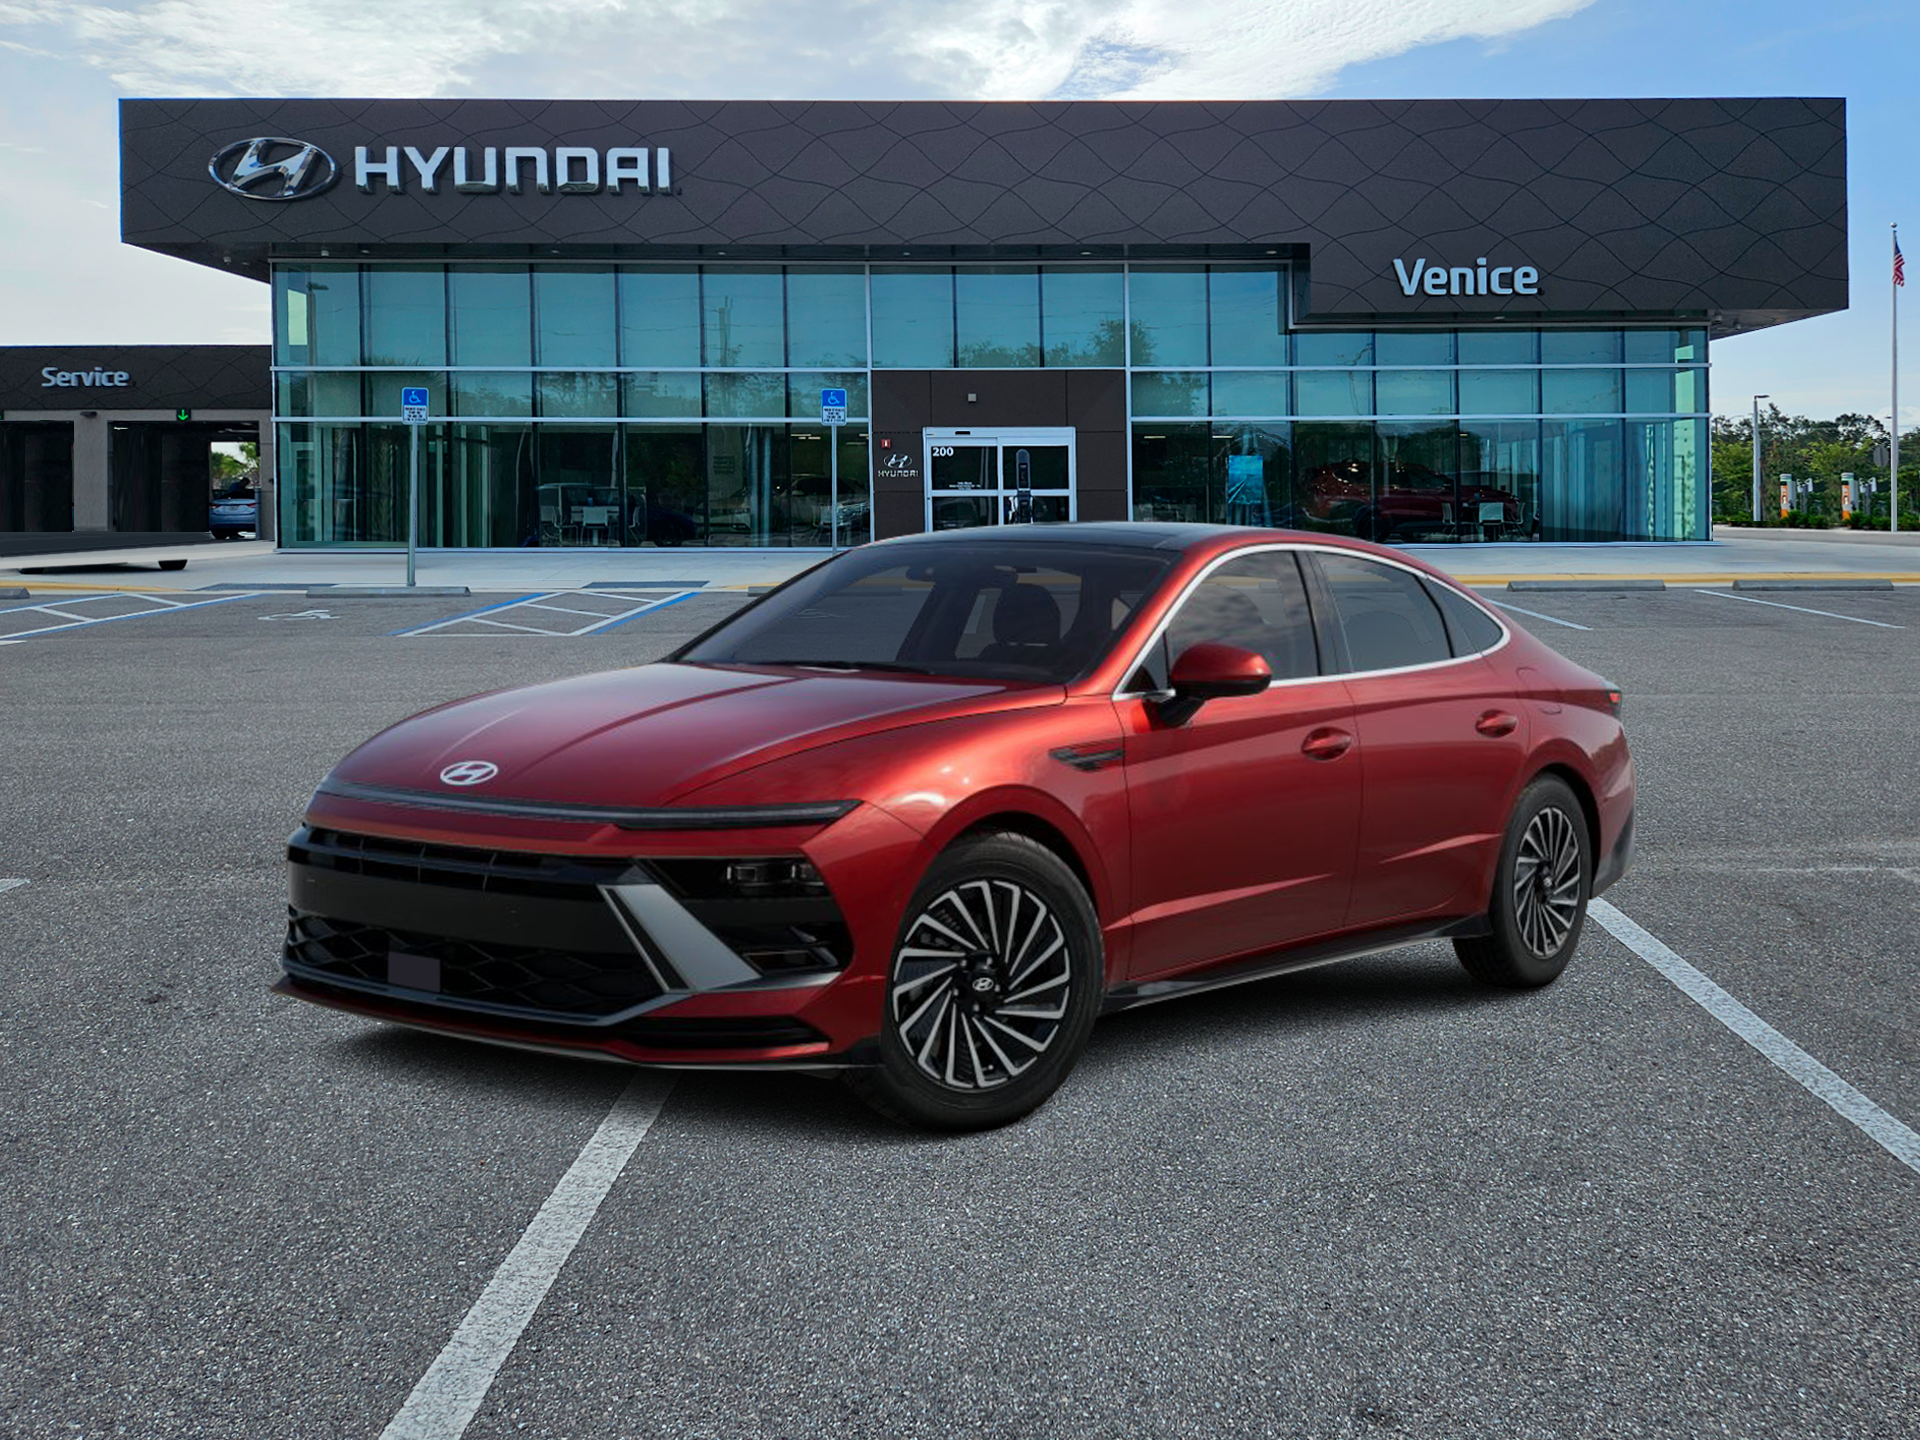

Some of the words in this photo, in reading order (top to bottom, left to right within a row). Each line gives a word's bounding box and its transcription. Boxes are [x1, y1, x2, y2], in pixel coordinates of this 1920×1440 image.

[354, 146, 672, 194] HYUNDAI
[1393, 257, 1539, 296] Venice
[41, 366, 130, 387] Service
[932, 446, 954, 457] 200
[877, 470, 919, 478] HYUNDAI
